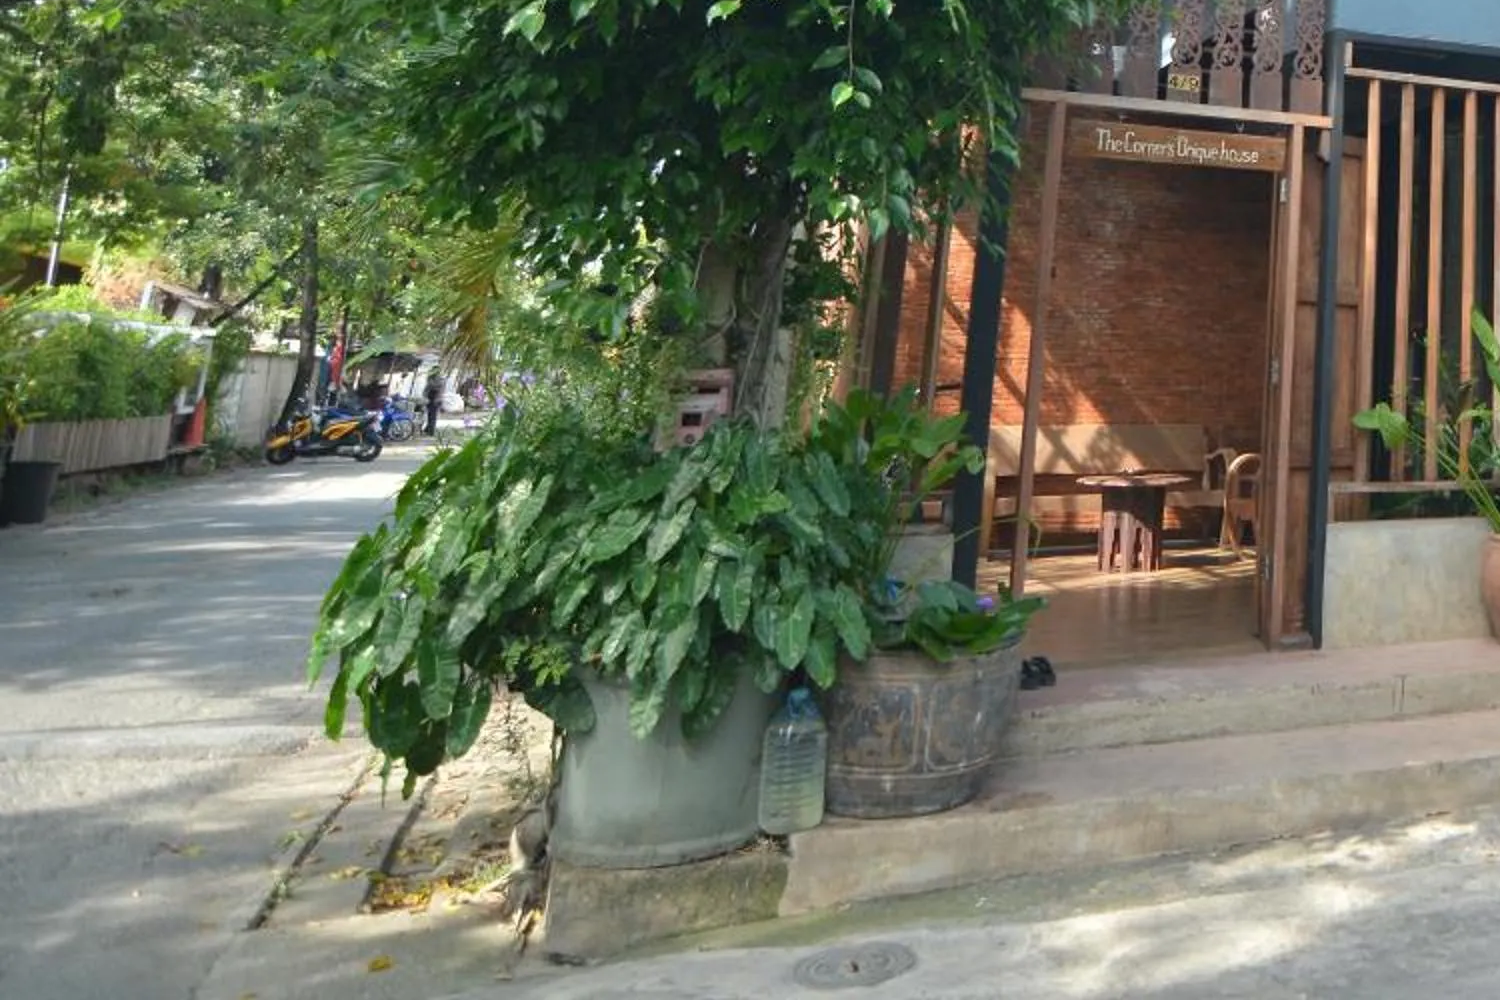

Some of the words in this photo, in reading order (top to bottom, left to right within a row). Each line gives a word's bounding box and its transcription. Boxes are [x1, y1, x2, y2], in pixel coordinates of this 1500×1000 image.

[1096, 128, 1122, 152] The
[1177, 136, 1218, 164] Unique
[1220, 139, 1259, 163] house
